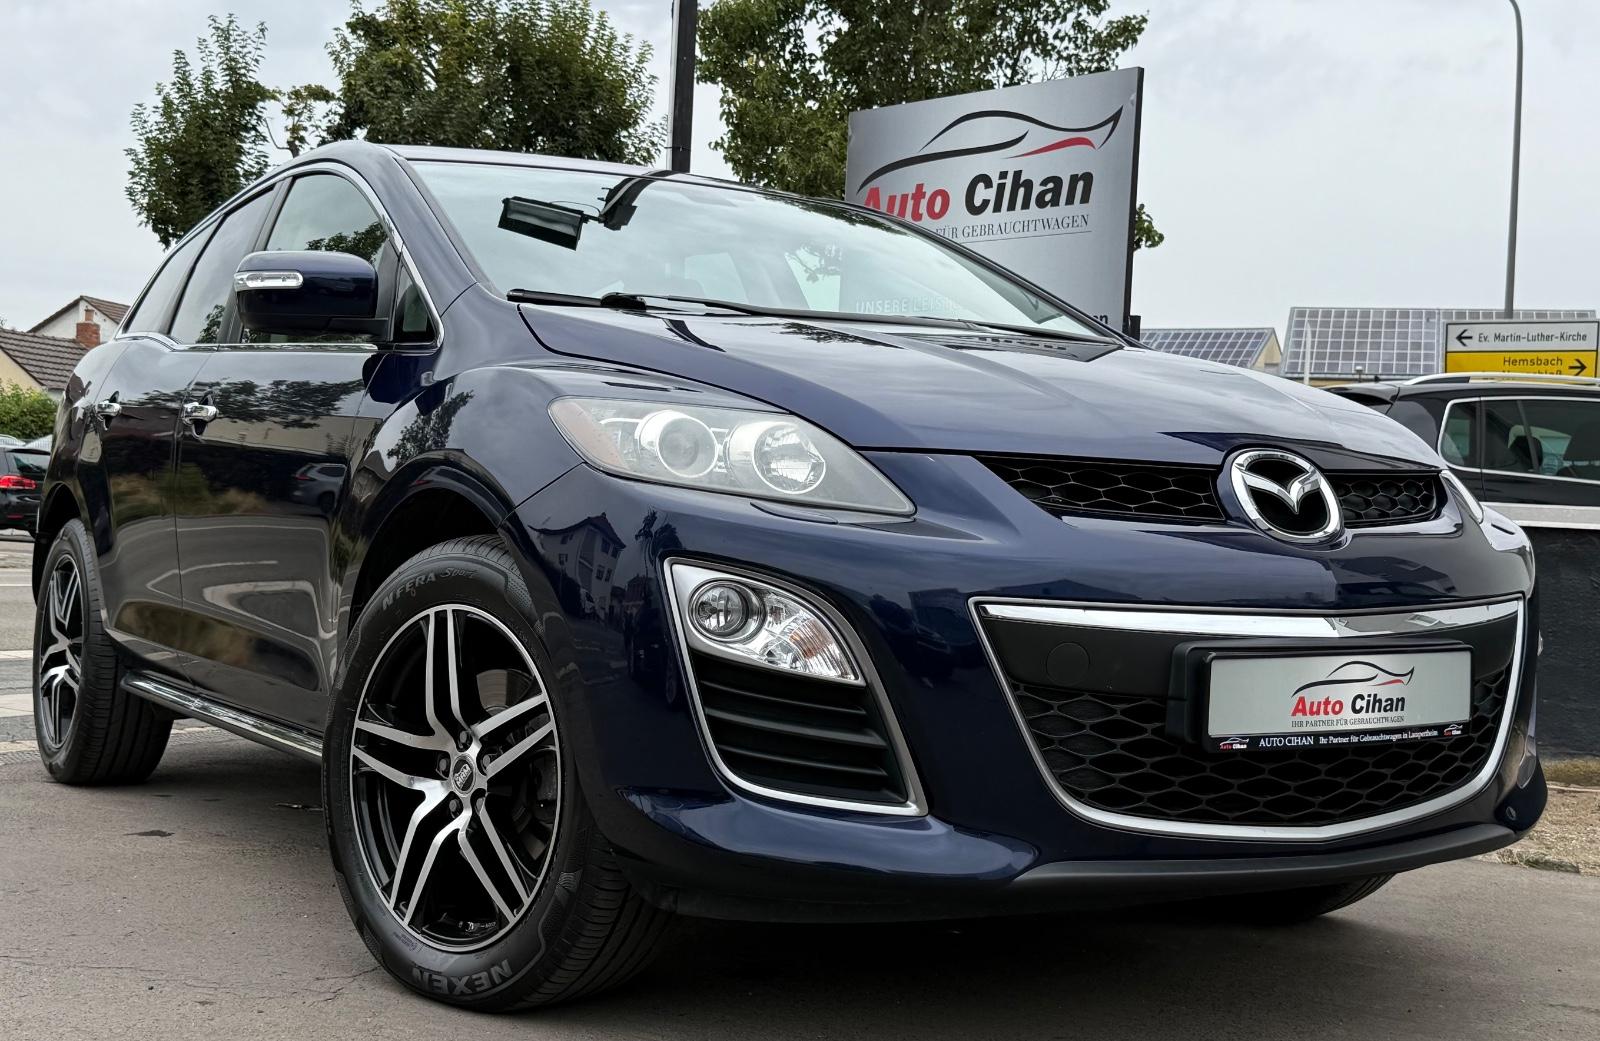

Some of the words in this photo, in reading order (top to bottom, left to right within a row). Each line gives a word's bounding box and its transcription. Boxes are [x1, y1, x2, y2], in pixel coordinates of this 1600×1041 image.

[864, 183, 950, 222] Auto
[965, 170, 1094, 216] Cihan
[962, 214, 1089, 238] GEBRAUCHTWAGEN
[856, 299, 908, 313] UNSERE
[1478, 333, 1489, 342] Ev.
[1494, 332, 1587, 342] Martin-Luther-Kirche
[1503, 357, 1562, 366] Hemsbach
[1291, 695, 1344, 717] Auto
[1351, 693, 1405, 714] Cihan
[1305, 719, 1335, 727] PARTNER
[1336, 718, 1348, 726] FÜR
[1349, 716, 1405, 725] GEBRAUCHTWAGEN
[1259, 737, 1285, 746] AUTO
[1285, 736, 1314, 745] CIHAN
[1329, 736, 1349, 744] Partner
[1359, 733, 1402, 742] Gebrauchtwagen
[412, 960, 512, 994] NEXEN
